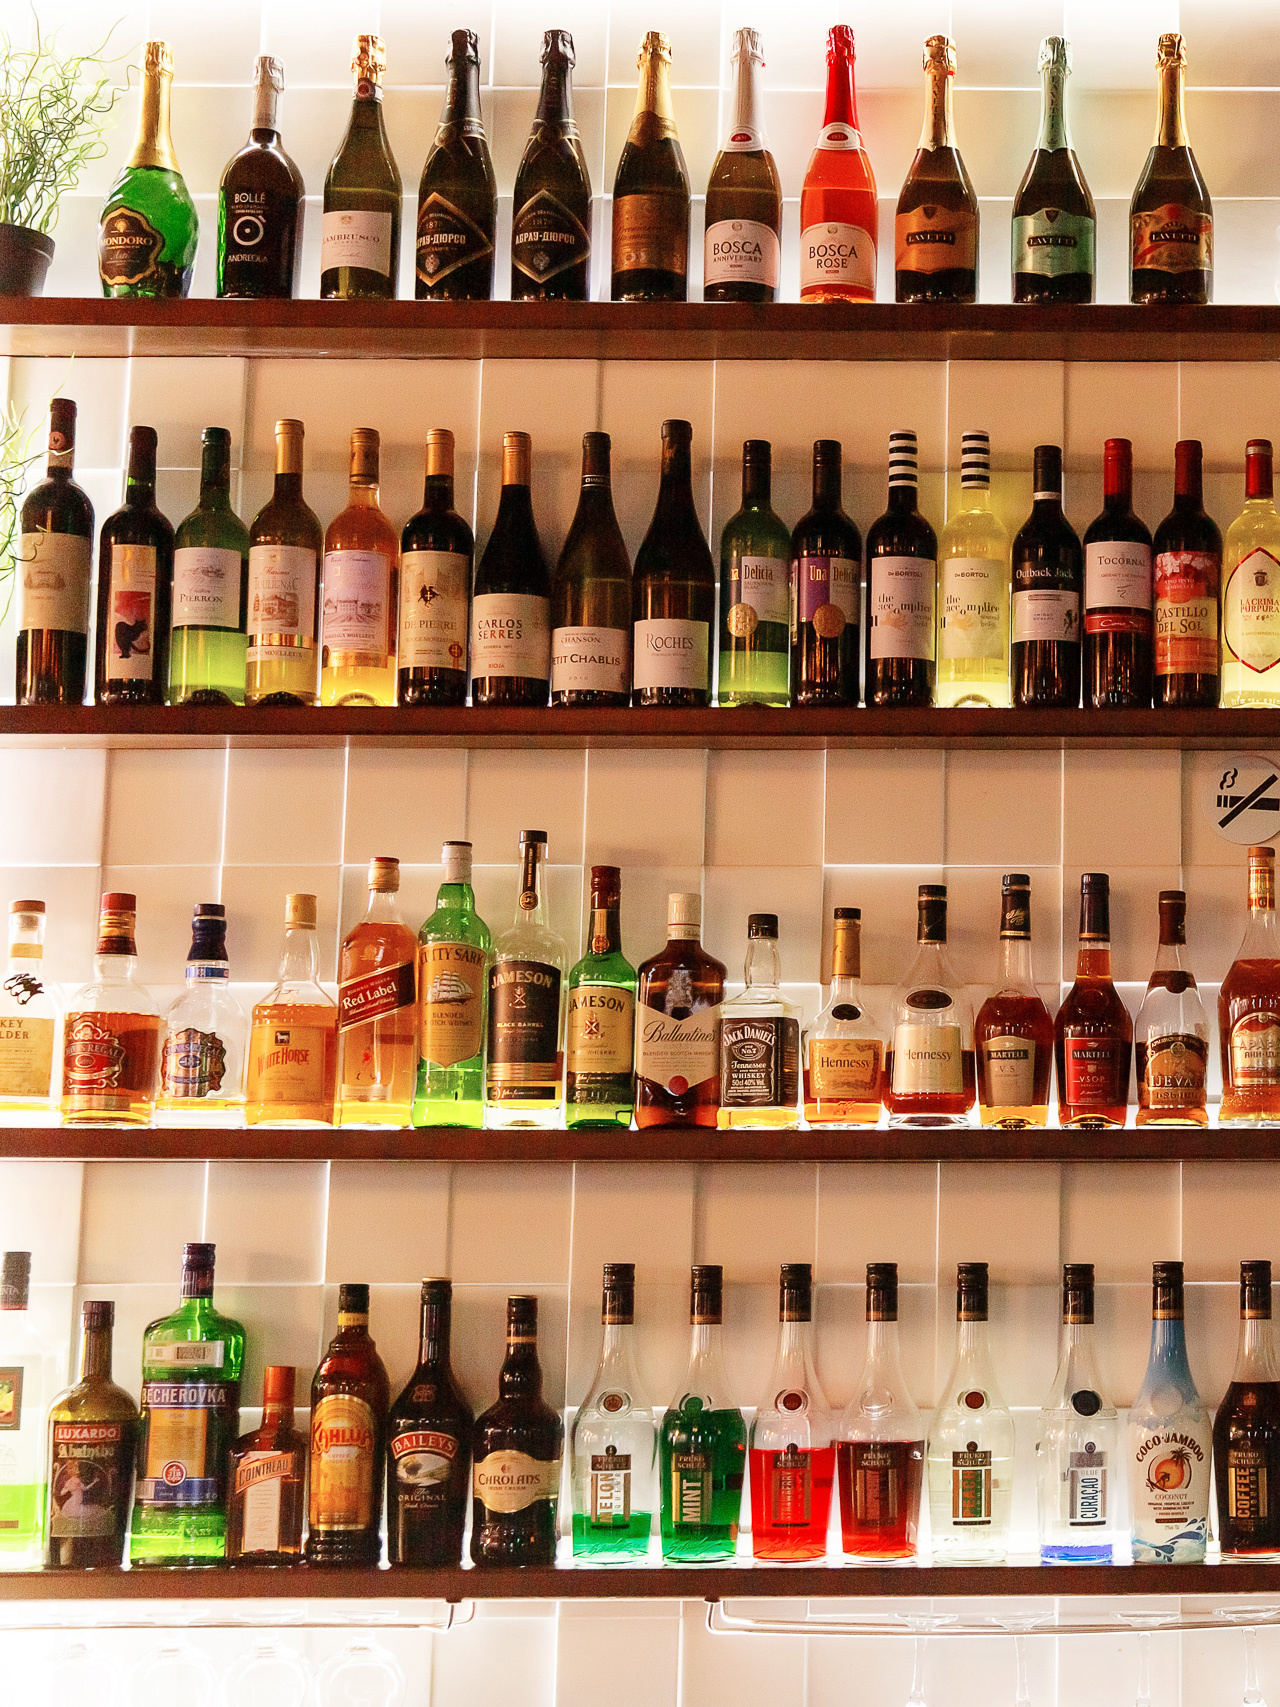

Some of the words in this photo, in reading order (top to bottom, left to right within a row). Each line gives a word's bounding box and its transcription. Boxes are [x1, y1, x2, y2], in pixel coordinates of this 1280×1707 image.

[515, 231, 576, 245] АБРАУ-ДЮРСО
[713, 241, 762, 256] BOSCA
[809, 244, 858, 260] BOSCA
[713, 254, 763, 264] ANNIVERSARY
[744, 564, 774, 581] Delicia
[809, 565, 828, 581] Una
[1016, 567, 1052, 579] Outback
[179, 593, 224, 603] PIERRON
[878, 593, 894, 603] the
[946, 595, 961, 605] the
[1156, 605, 1208, 623] CASTILLO
[478, 618, 523, 630] CARLOS
[1158, 622, 1177, 634] DEL
[1179, 618, 1204, 634] SOL
[478, 629, 523, 641] SERRES
[646, 632, 695, 653] ROCHES
[570, 653, 622, 666] CHABLIS
[454, 947, 485, 967] SARK
[491, 970, 553, 989] JAMESON
[342, 993, 366, 1010] Red
[366, 981, 398, 1001] Label
[568, 995, 626, 1015] JAMESON
[641, 1020, 717, 1044] Ballantine's
[723, 1031, 745, 1047] JACK
[745, 1026, 777, 1046] DANIEL'S
[88, 1043, 119, 1058] REGAL
[990, 1051, 1025, 1060] MARTELL
[1072, 1051, 1111, 1060] MARTELL
[258, 1050, 281, 1076] WHITE
[281, 1046, 310, 1067] HORSE
[731, 1061, 767, 1070] Tennessee
[821, 1056, 871, 1070] Hennessy
[731, 1072, 766, 1080] WHISKEY
[141, 1386, 226, 1405] BECHEROVKA
[58, 1427, 117, 1440] LUXARDO
[394, 1434, 454, 1453] BAILEYS
[1136, 1435, 1162, 1463] COCO
[1163, 1432, 1204, 1462] JAMBOO
[239, 1456, 291, 1488] COINTREAU
[478, 1473, 542, 1486] CAROLANS
[1080, 1468, 1099, 1476] BLUE
[398, 1493, 446, 1502] ORIGINAL
[1080, 1477, 1104, 1519] CURAÇAO
[1155, 1493, 1188, 1501] COCONUT
[1237, 1467, 1250, 1518] COFFEE
[682, 1478, 702, 1523] MINT
